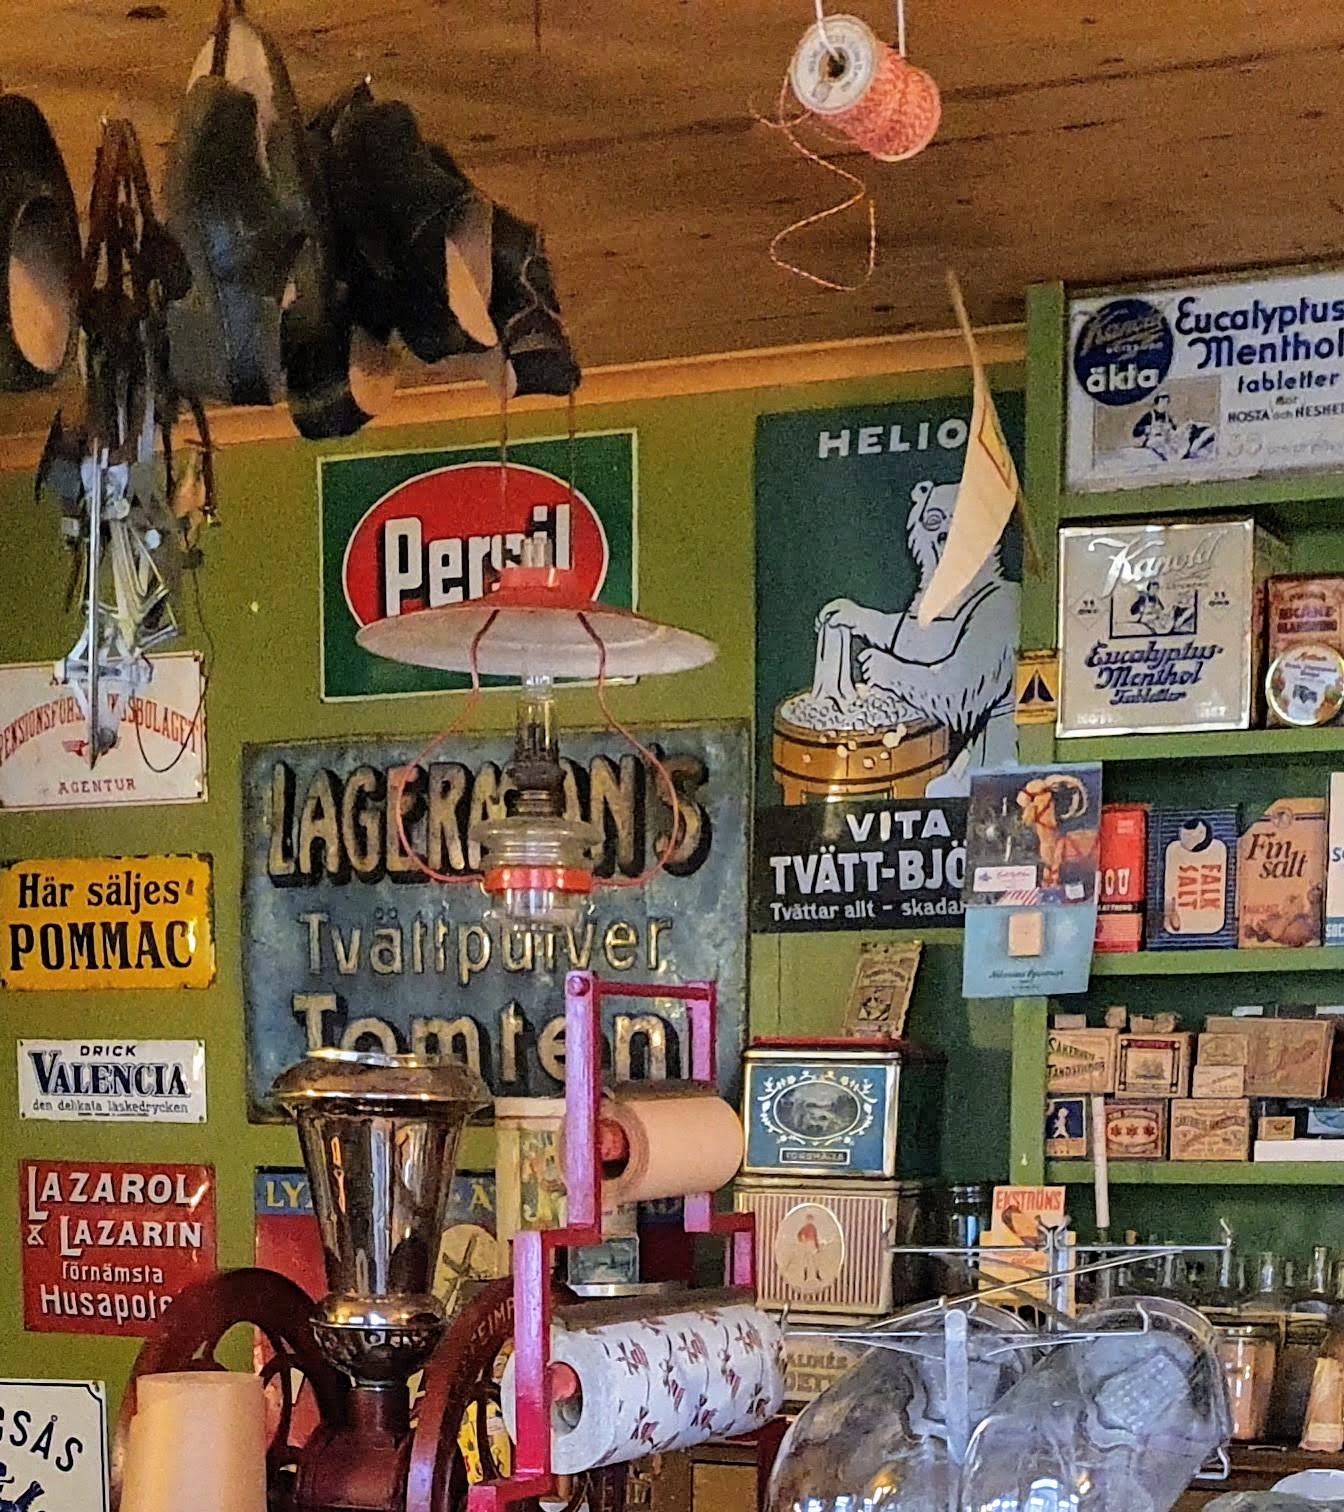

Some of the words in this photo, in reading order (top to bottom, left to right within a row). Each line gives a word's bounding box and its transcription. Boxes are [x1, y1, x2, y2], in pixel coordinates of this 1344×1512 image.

[1085, 361, 1160, 393] äkta
[1237, 370, 1340, 394] tabletter
[1227, 409, 1270, 424] HOSTA
[1095, 661, 1202, 690] Menthol
[58, 778, 137, 795] AGENTUR
[846, 810, 953, 842] VITA
[1245, 832, 1293, 863] Fin
[768, 840, 968, 897] TVÄTT-BJÖ
[1258, 850, 1309, 880] salt
[17, 872, 74, 909] Här
[86, 870, 180, 912] säljes
[1177, 864, 1198, 911] SALT
[1200, 863, 1222, 912] FALK
[769, 898, 838, 923] Tvättar
[844, 898, 877, 922] allt
[9, 919, 194, 972] POMMAC
[79, 1044, 137, 1057] DRICK
[27, 1050, 192, 1098] VALENCIA
[32, 1098, 53, 1112] den
[107, 1099, 189, 1116] läskedrycken
[26, 1165, 199, 1222] LAZAROL
[995, 1188, 1062, 1211] EKSTRÖMS
[59, 1214, 203, 1258] LAZARIN
[61, 1260, 164, 1284] förnämsta
